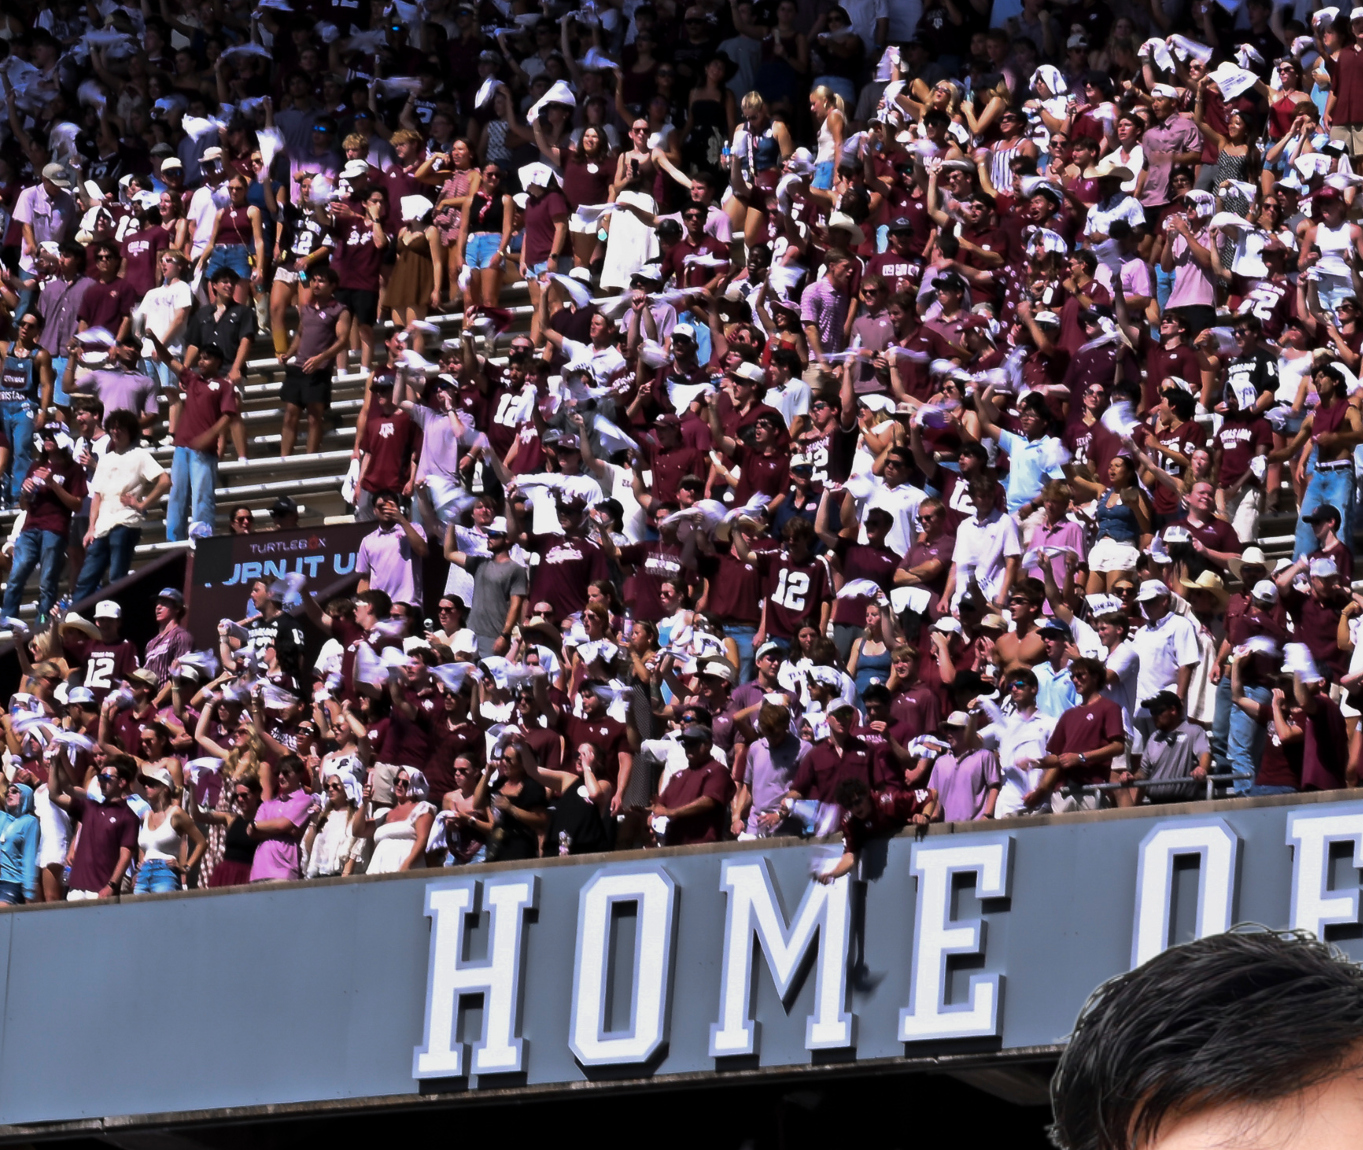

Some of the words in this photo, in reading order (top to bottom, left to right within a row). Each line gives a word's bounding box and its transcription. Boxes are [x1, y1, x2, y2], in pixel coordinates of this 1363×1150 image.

[334, 551, 358, 575] U
[772, 569, 811, 611] 12
[85, 658, 115, 689] 12
[412, 835, 1014, 1080] HOME
